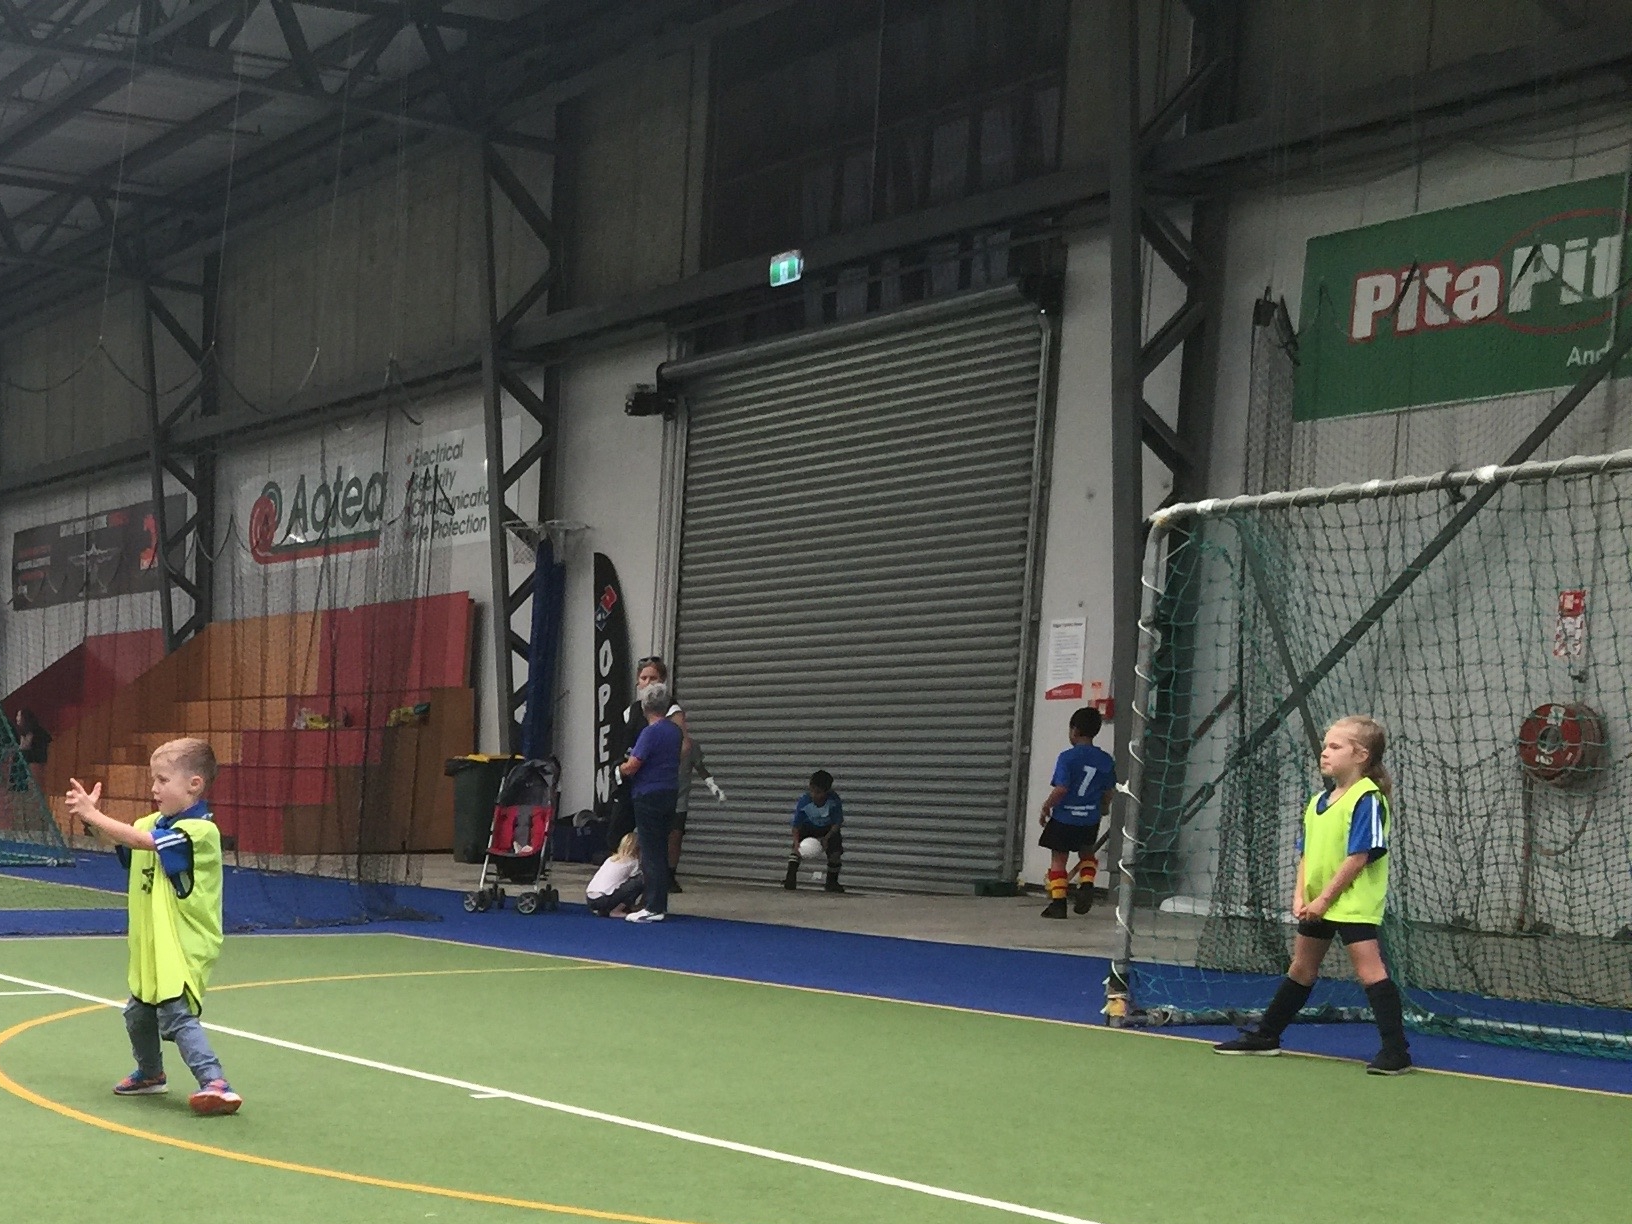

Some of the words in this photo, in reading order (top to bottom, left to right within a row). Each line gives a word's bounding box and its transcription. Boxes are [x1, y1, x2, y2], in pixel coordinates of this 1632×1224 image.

[1351, 264, 1501, 340] Pita
[413, 438, 465, 468] Electrical
[411, 467, 457, 493] Secrity
[286, 465, 389, 533] Aotea
[433, 513, 487, 540] Protection
[596, 639, 614, 803] OPEN
[1077, 764, 1097, 797] 7
